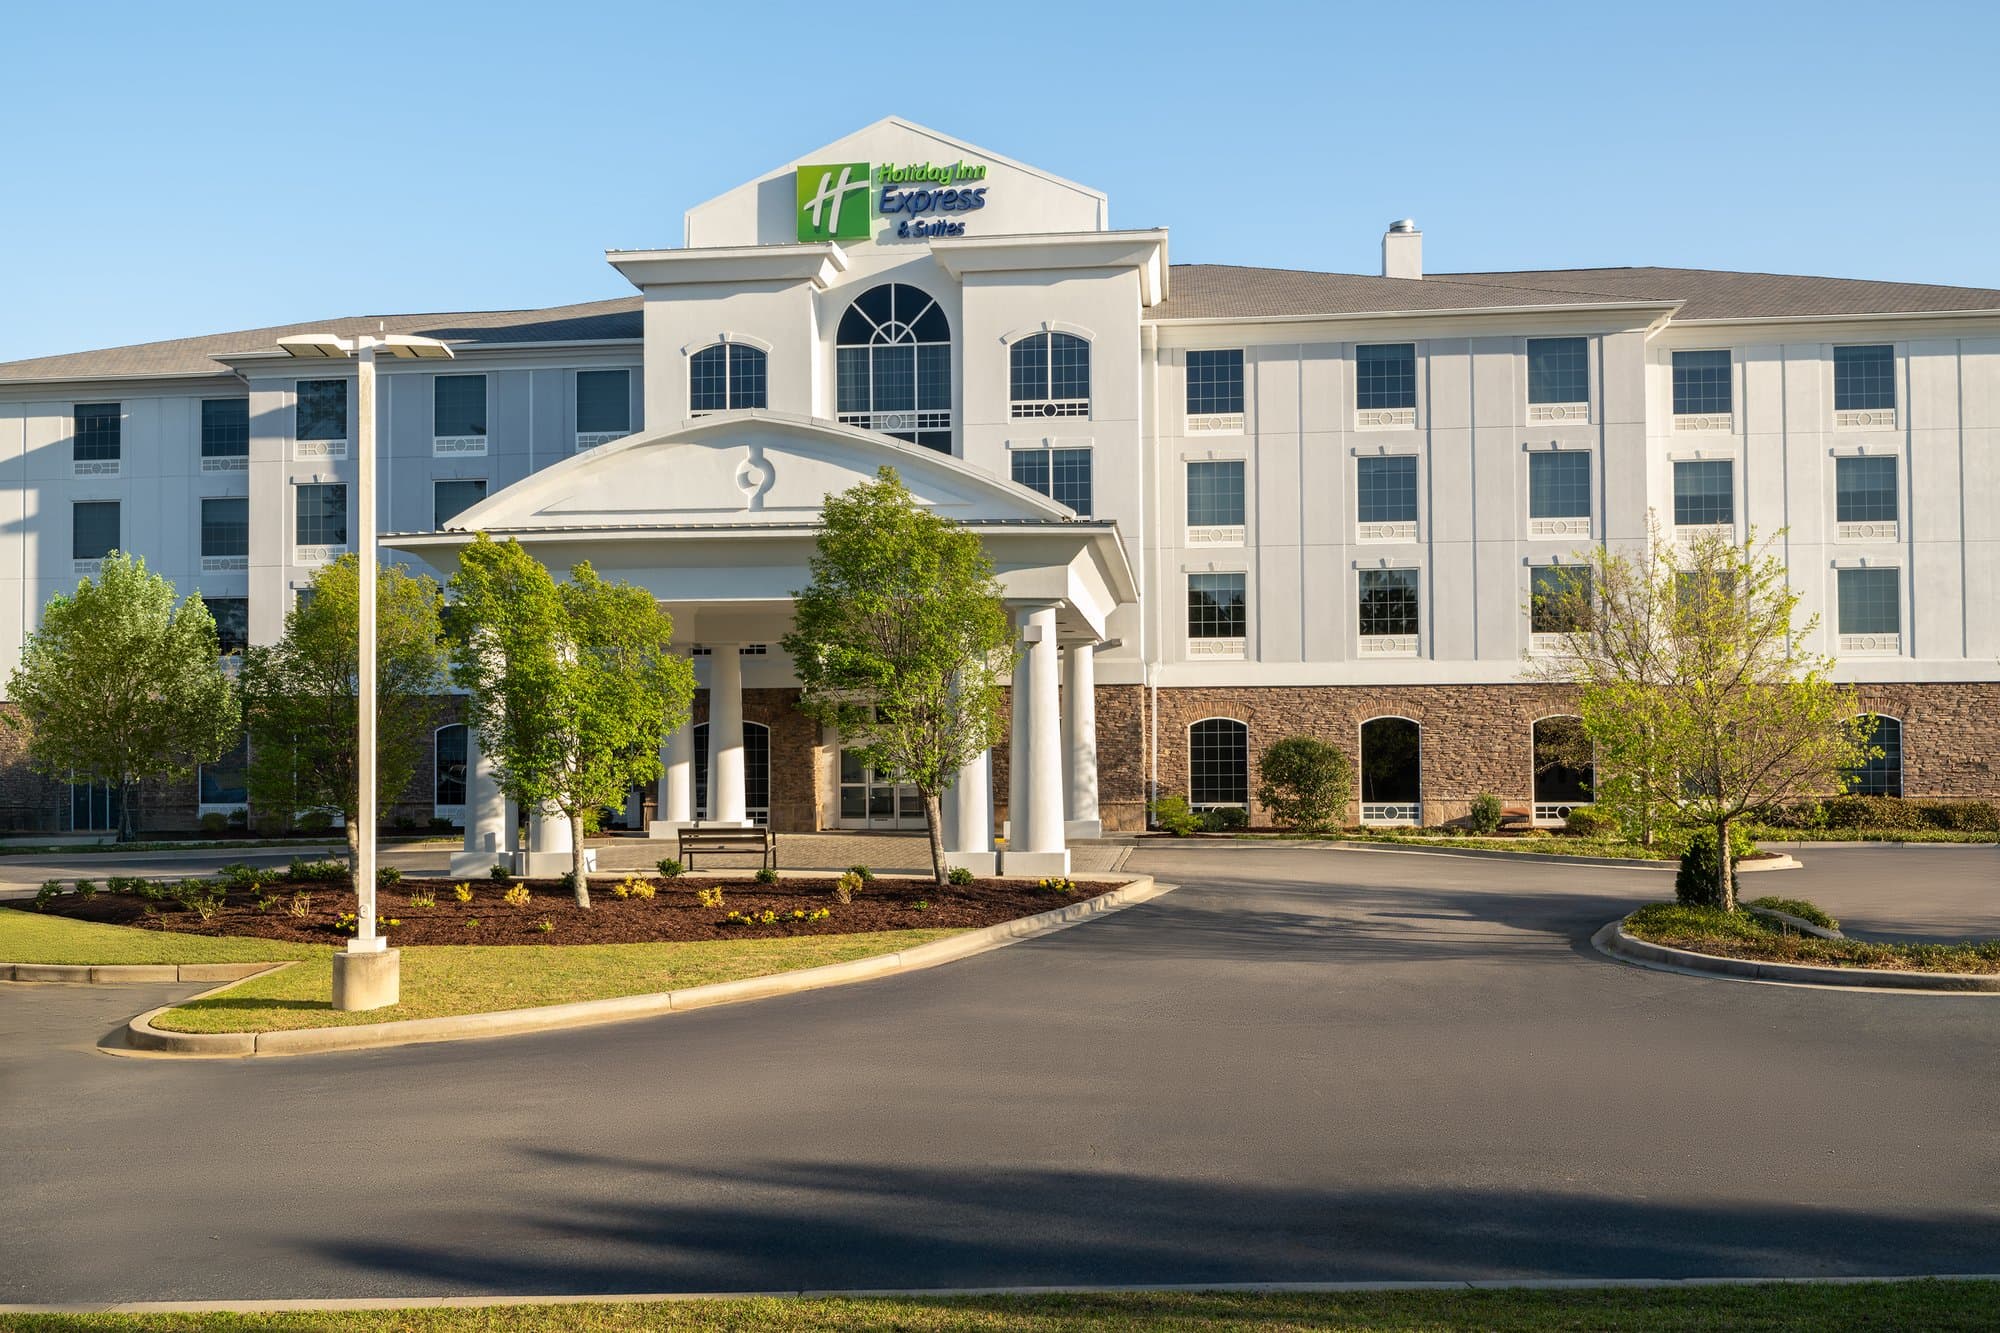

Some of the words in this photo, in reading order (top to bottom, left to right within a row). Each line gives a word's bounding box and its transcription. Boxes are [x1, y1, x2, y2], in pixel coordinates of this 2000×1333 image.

[878, 162, 951, 185] Holiday
[956, 160, 986, 180] Inn
[803, 167, 870, 233] H
[878, 185, 986, 219] Express
[897, 221, 911, 239] &
[913, 219, 966, 238] Suites
